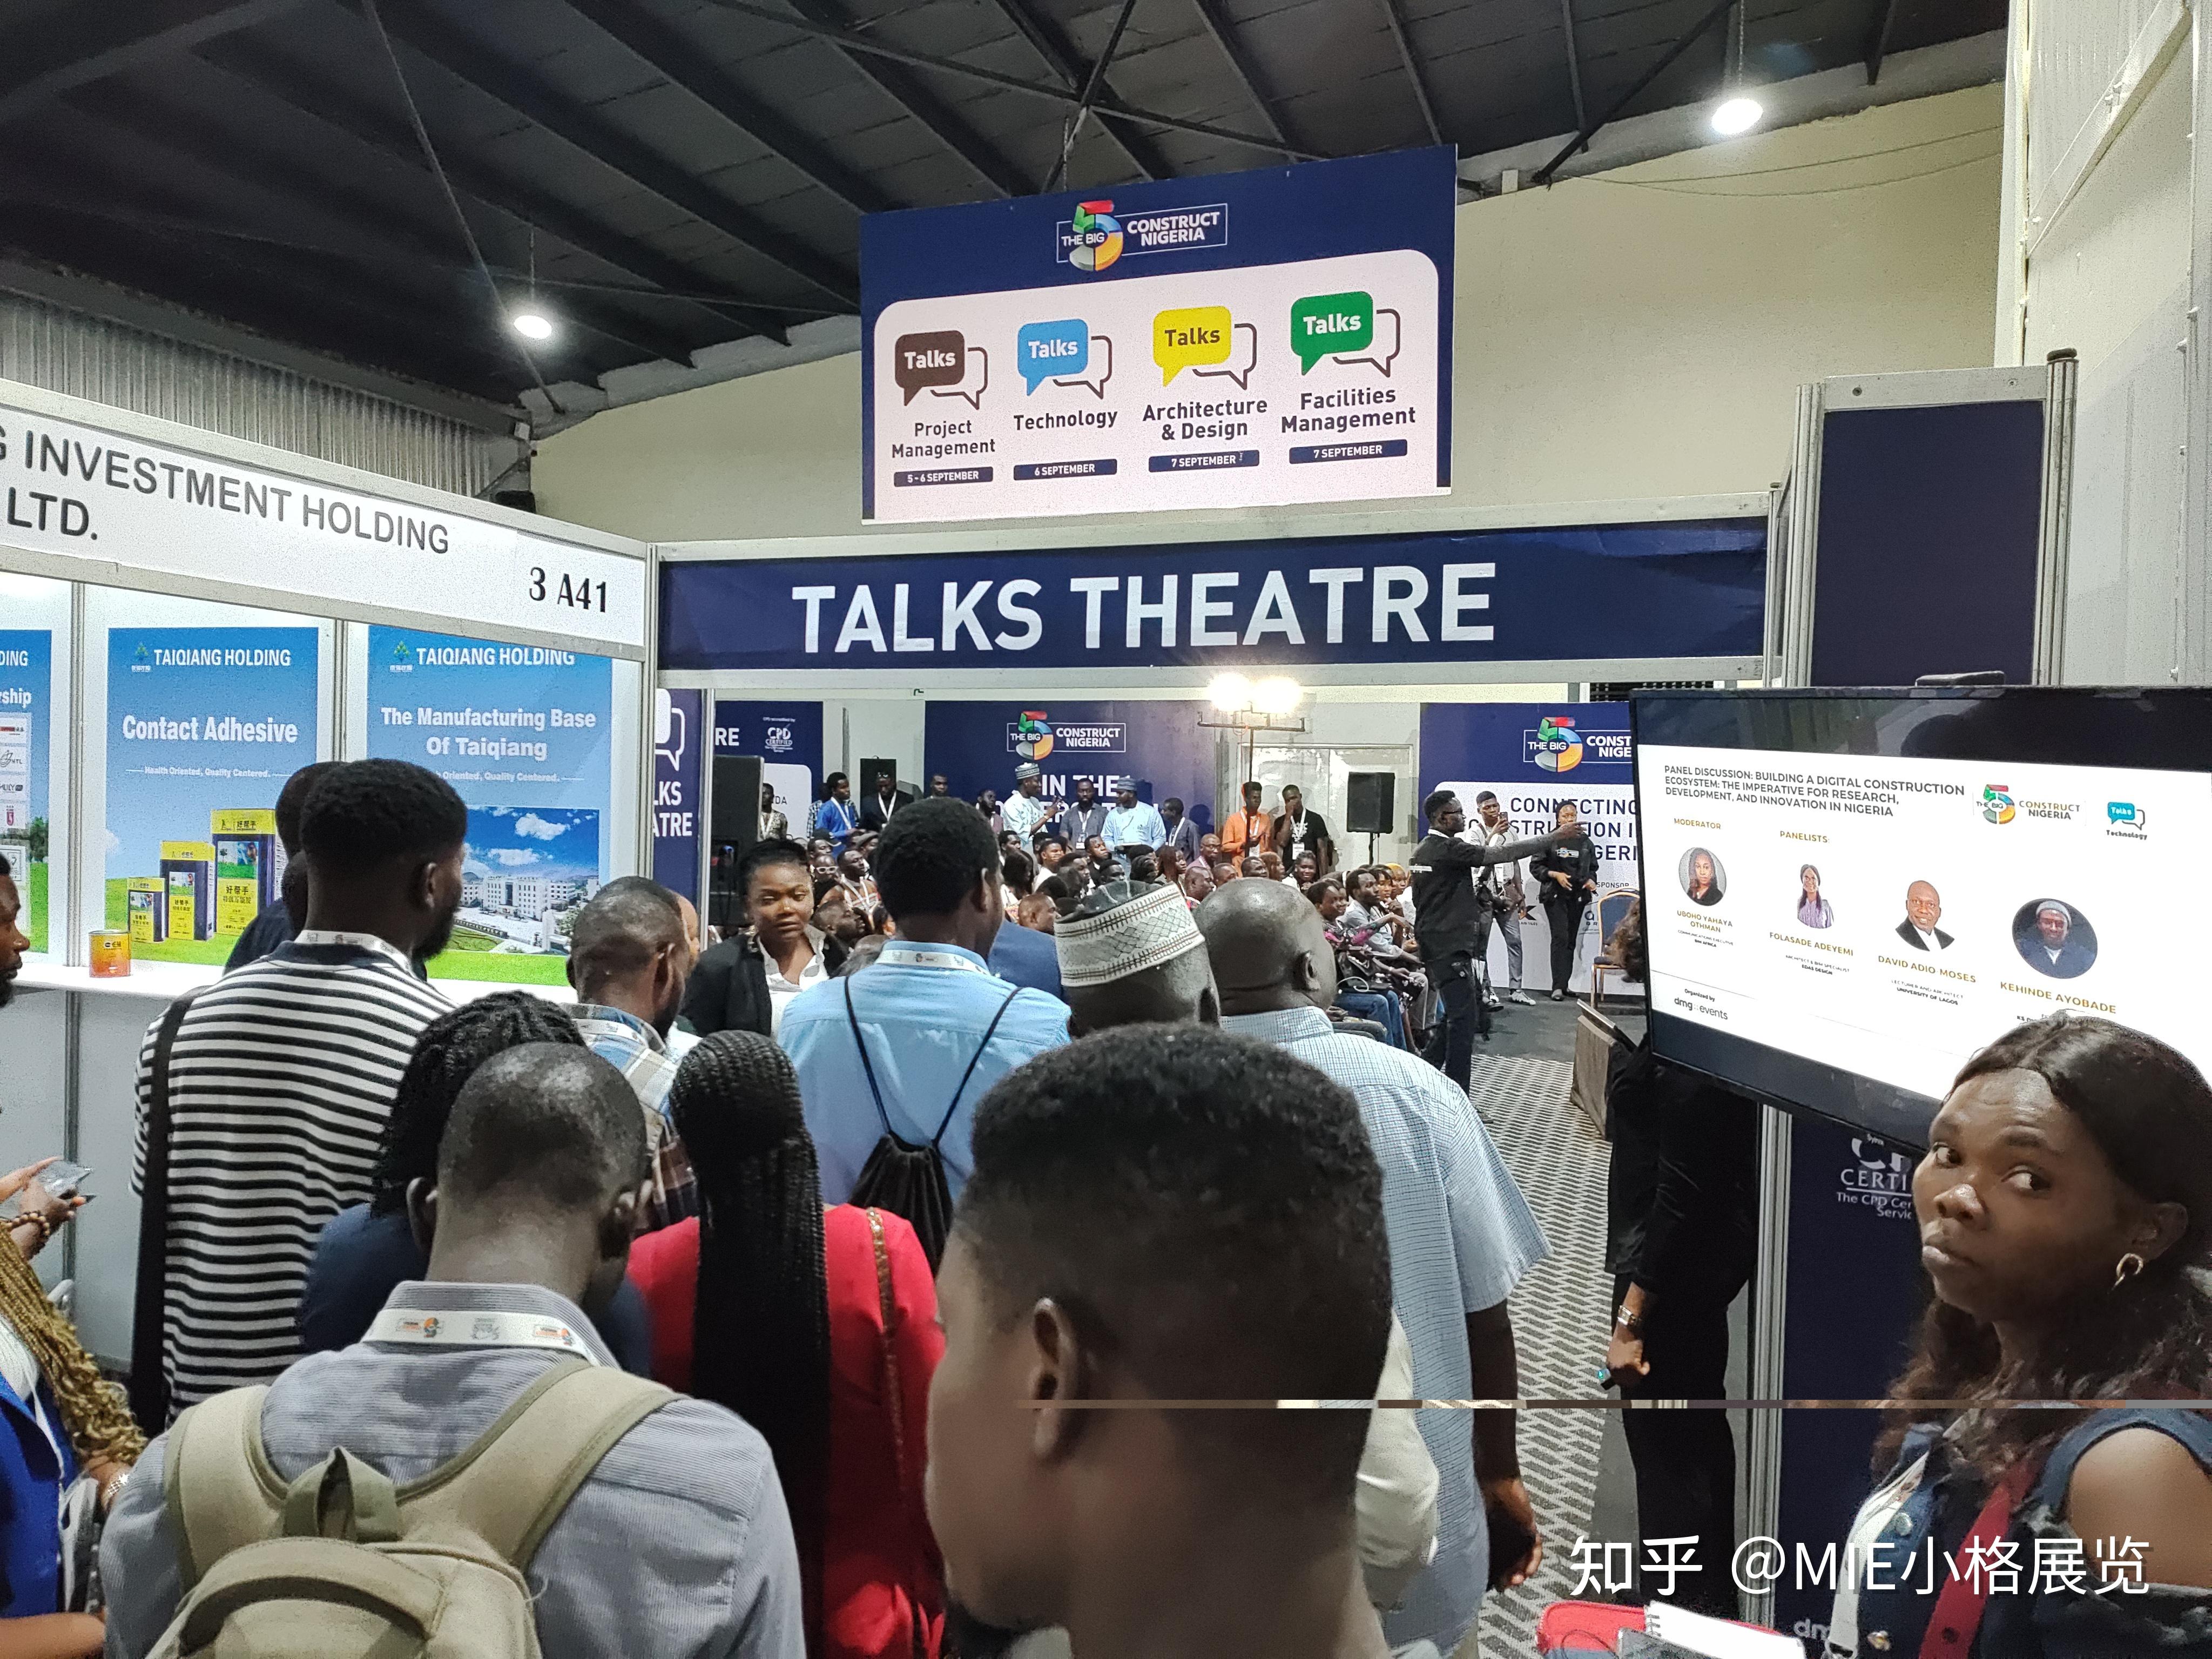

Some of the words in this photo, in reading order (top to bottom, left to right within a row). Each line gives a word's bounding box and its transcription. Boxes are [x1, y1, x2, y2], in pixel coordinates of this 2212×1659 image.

[1127, 212, 1220, 234] CONSTRUCT
[1061, 235, 1083, 246] THE
[1086, 233, 1104, 244] BIG
[1141, 228, 1205, 246] NIGERIA
[1303, 313, 1362, 335] Talks
[1164, 328, 1220, 347] Talks
[1028, 340, 1078, 359] Talks
[904, 349, 956, 370] Talks
[1300, 387, 1397, 410] Facilities
[1143, 399, 1268, 422] Architecture
[1282, 407, 1416, 433] Management
[915, 420, 972, 439] Project
[1014, 410, 1118, 431] Technology
[1161, 424, 1175, 440] &
[1182, 420, 1248, 441] Design
[892, 439, 995, 459] Management
[1313, 450, 1320, 458] 7
[1321, 445, 1382, 458] SEPTEMBER
[1035, 467, 1040, 476] 6
[1042, 464, 1096, 476] SEPTEMBER
[1171, 458, 1177, 467] 7
[1178, 455, 1236, 467] SEPTEMBER
[927, 471, 979, 482] SEPTEMBER
[25, 430, 292, 522] INVESTMENT
[302, 494, 449, 554] HOLDING
[8, 487, 98, 540] LTD.
[529, 566, 547, 601] 3
[557, 572, 607, 613] A41
[792, 578, 1043, 653] TALKS
[1070, 562, 1496, 649] THEATRE
[154, 649, 221, 666] TAIQIANG
[225, 649, 292, 667] HOLDING
[416, 648, 496, 666] TAIQIANG
[499, 648, 576, 666] HOLDING
[0, 687, 32, 709] ship
[380, 706, 413, 725] The
[417, 707, 545, 732] Manufacturing
[550, 708, 597, 728] Base
[123, 714, 199, 741] Contact
[204, 716, 299, 744] Adhesive
[767, 727, 792, 740] CPD
[1010, 733, 1026, 741] THE
[1027, 733, 1041, 741] BIG
[1056, 727, 1121, 738] CONSTRUCT
[426, 736, 451, 756] Of
[455, 736, 548, 762] Taiqiang
[1065, 737, 1111, 747] NIGERIA
[1527, 741, 1548, 750] THE
[1549, 741, 1567, 750] BIG
[1586, 736, 1631, 746] CONST
[1599, 747, 1632, 758] NIGE
[145, 766, 168, 775] Health
[169, 767, 204, 776] Oriented,
[205, 767, 231, 778] Quality
[443, 771, 483, 781] Oriented,
[484, 771, 515, 783] Quality
[1664, 765, 1693, 776] PANEL
[1695, 767, 1754, 780] DISCUSSION:
[1756, 771, 1804, 784] BUILDING
[1806, 775, 1815, 785] A
[1817, 776, 1862, 788] DIGITAL
[1864, 779, 1965, 796] CONSTRUCTION
[1665, 776, 1720, 788] ECOSYSTEM:
[1722, 780, 1741, 790] THE
[1743, 782, 1804, 796] IMPERATIVE
[1807, 787, 1829, 798] FOR
[1832, 790, 1899, 805] RESEARCH,
[1665, 787, 1735, 802] DEVELOPMENT,
[1736, 794, 1758, 803] AND
[1759, 795, 1827, 810] INNOVATION
[1830, 802, 1841, 812] IN
[1844, 803, 1893, 817] NIGERIA
[2019, 800, 2080, 812] CONSTRUCT
[1674, 818, 1722, 830] MODERATOR
[2028, 809, 2072, 820] NIGERIA
[2106, 830, 2148, 840] Technology
[1677, 909, 1702, 921] UBOHO
[1703, 915, 1734, 928] YAHAYA
[1690, 921, 1721, 933] OTHMAN
[1769, 932, 1812, 948] FOLASADE
[1814, 942, 1853, 956] ADEYEMI
[1878, 955, 1908, 968] DAVID
[1684, 988, 1709, 1000] Organized
[2000, 981, 2052, 1000] KEHINDE
[2055, 994, 2117, 1014] AYOBADE
[1840, 1168, 1907, 1191] CERTI
[1836, 1191, 1858, 1204] The
[1861, 1194, 1888, 1206] CPD
